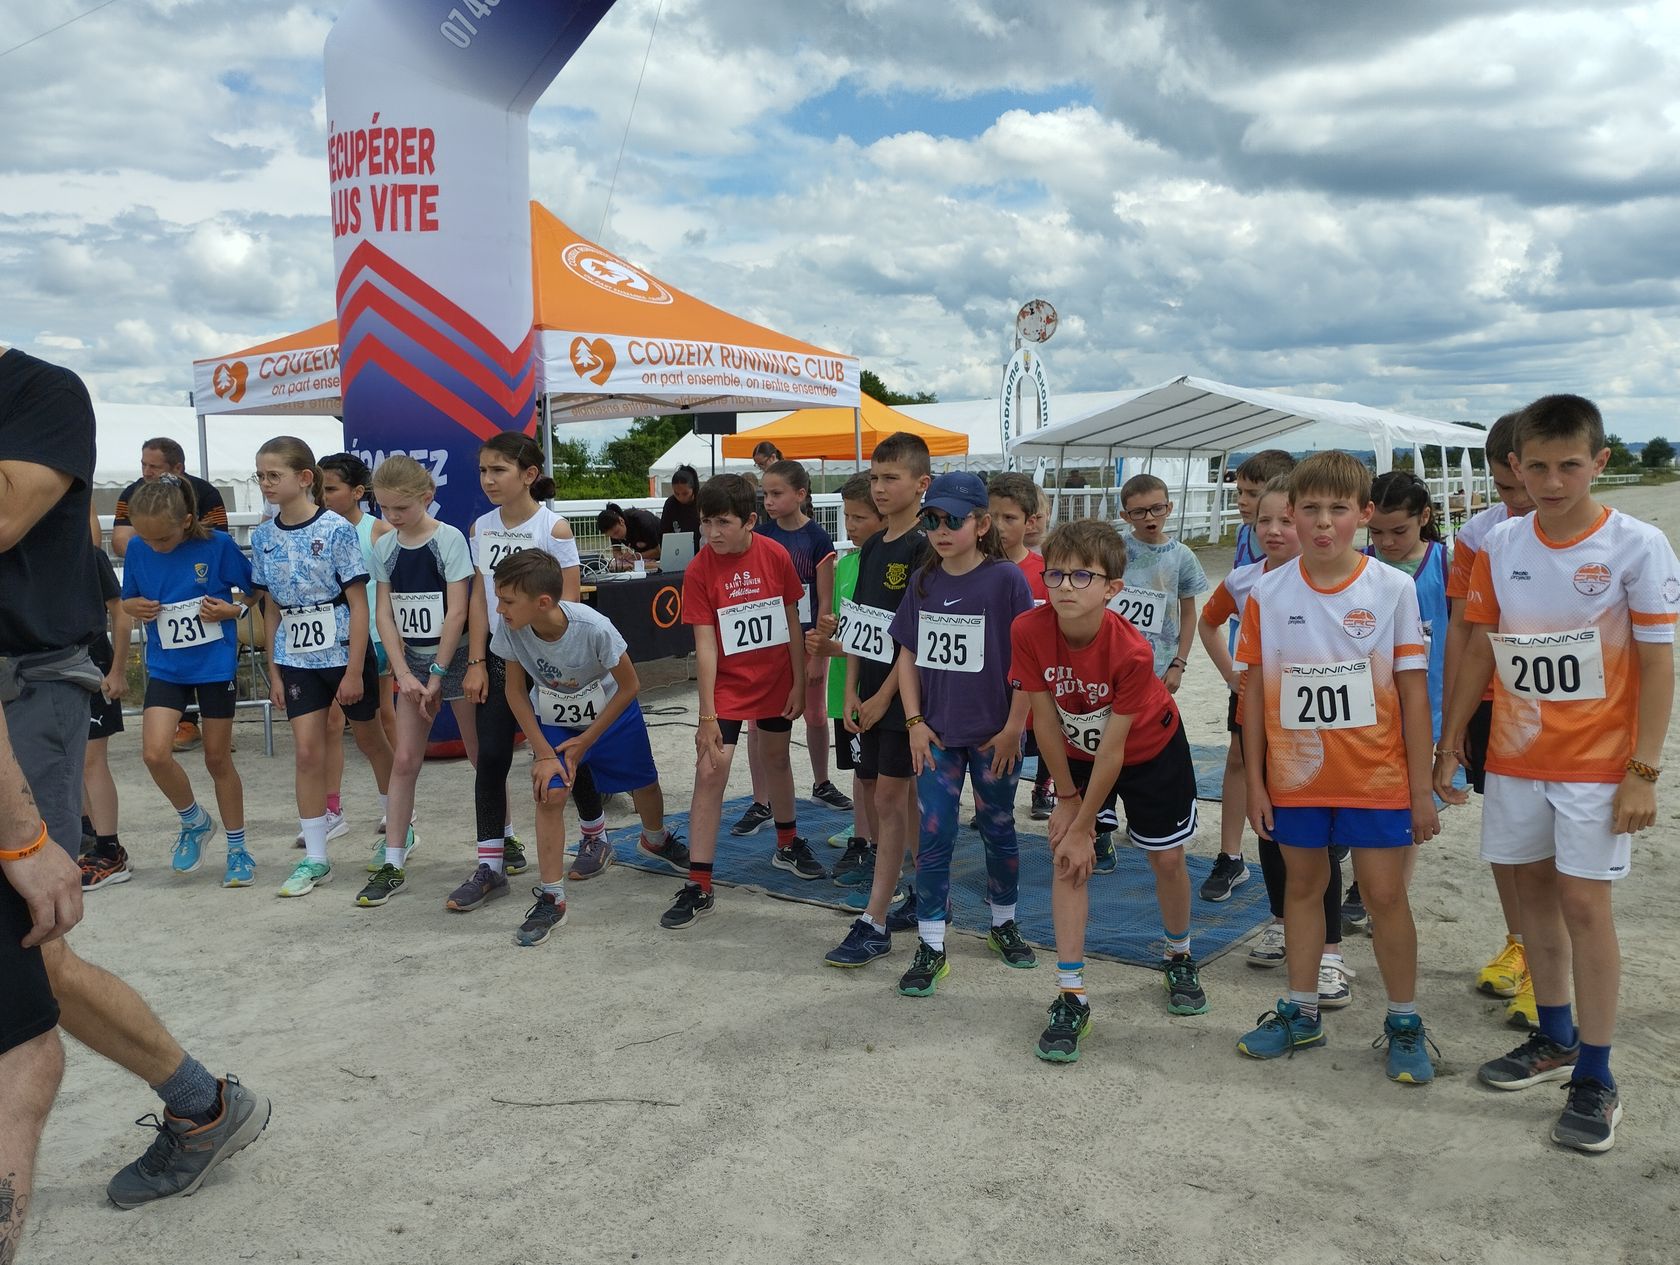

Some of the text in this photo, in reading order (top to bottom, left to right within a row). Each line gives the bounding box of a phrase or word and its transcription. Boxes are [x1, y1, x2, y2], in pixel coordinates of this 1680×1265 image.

[328, 112, 435, 184] ÉCUPÉRER
[331, 184, 439, 238] LUS VITE
[259, 347, 340, 380] COUZEIX
[627, 340, 845, 382] COUZEIX RUNNING CLUB
[271, 376, 340, 396] on part ense
[641, 372, 657, 384] on
[660, 370, 684, 387] part
[746, 377, 760, 389] on
[792, 382, 838, 398] ensemble
[168, 614, 206, 643] 231
[400, 607, 432, 633] 240
[1118, 599, 1155, 627] 229
[291, 620, 326, 648] 228
[734, 614, 773, 648] 207
[851, 620, 883, 655] 225
[927, 630, 968, 665] 235
[1511, 654, 1581, 694] 200
[553, 700, 598, 724] 234
[1297, 684, 1351, 723] 201
[1065, 723, 1101, 752] 26
